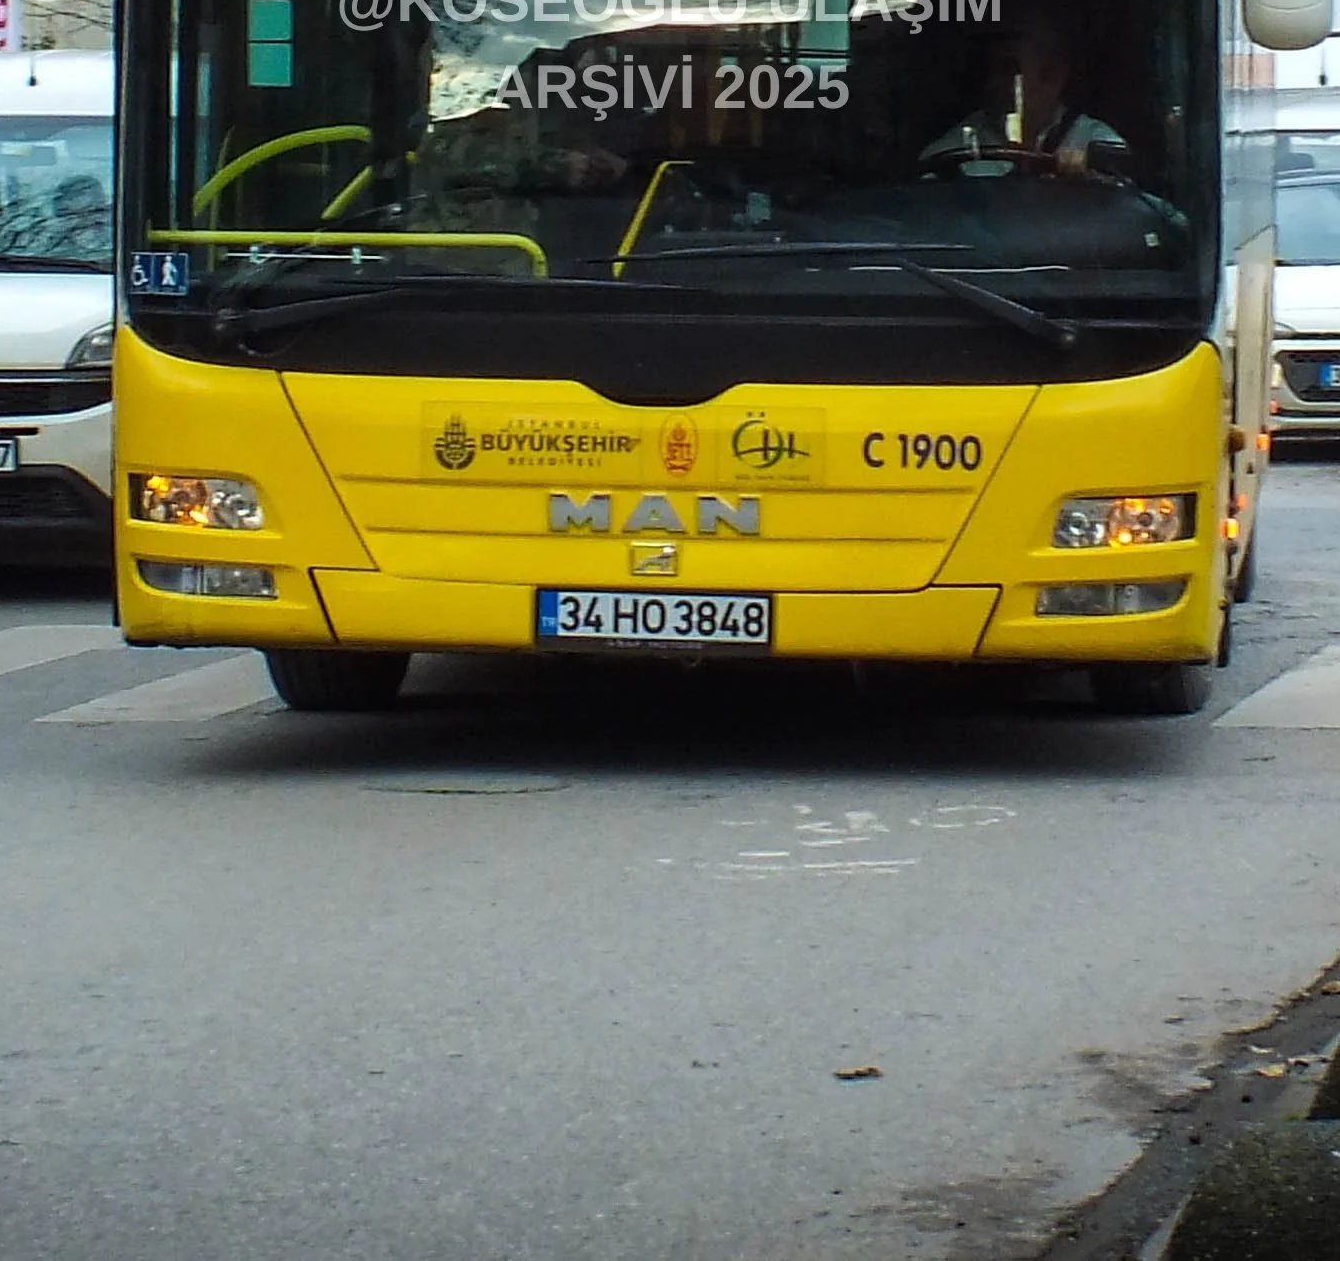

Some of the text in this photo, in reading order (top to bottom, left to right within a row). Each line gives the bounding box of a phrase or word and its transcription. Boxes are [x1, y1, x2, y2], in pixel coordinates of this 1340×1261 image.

[481, 428, 632, 456] BÜYÜKŞEHİR
[863, 432, 981, 470] C 1900
[549, 490, 761, 534] MAN
[560, 596, 765, 638] 34 HO 3848
